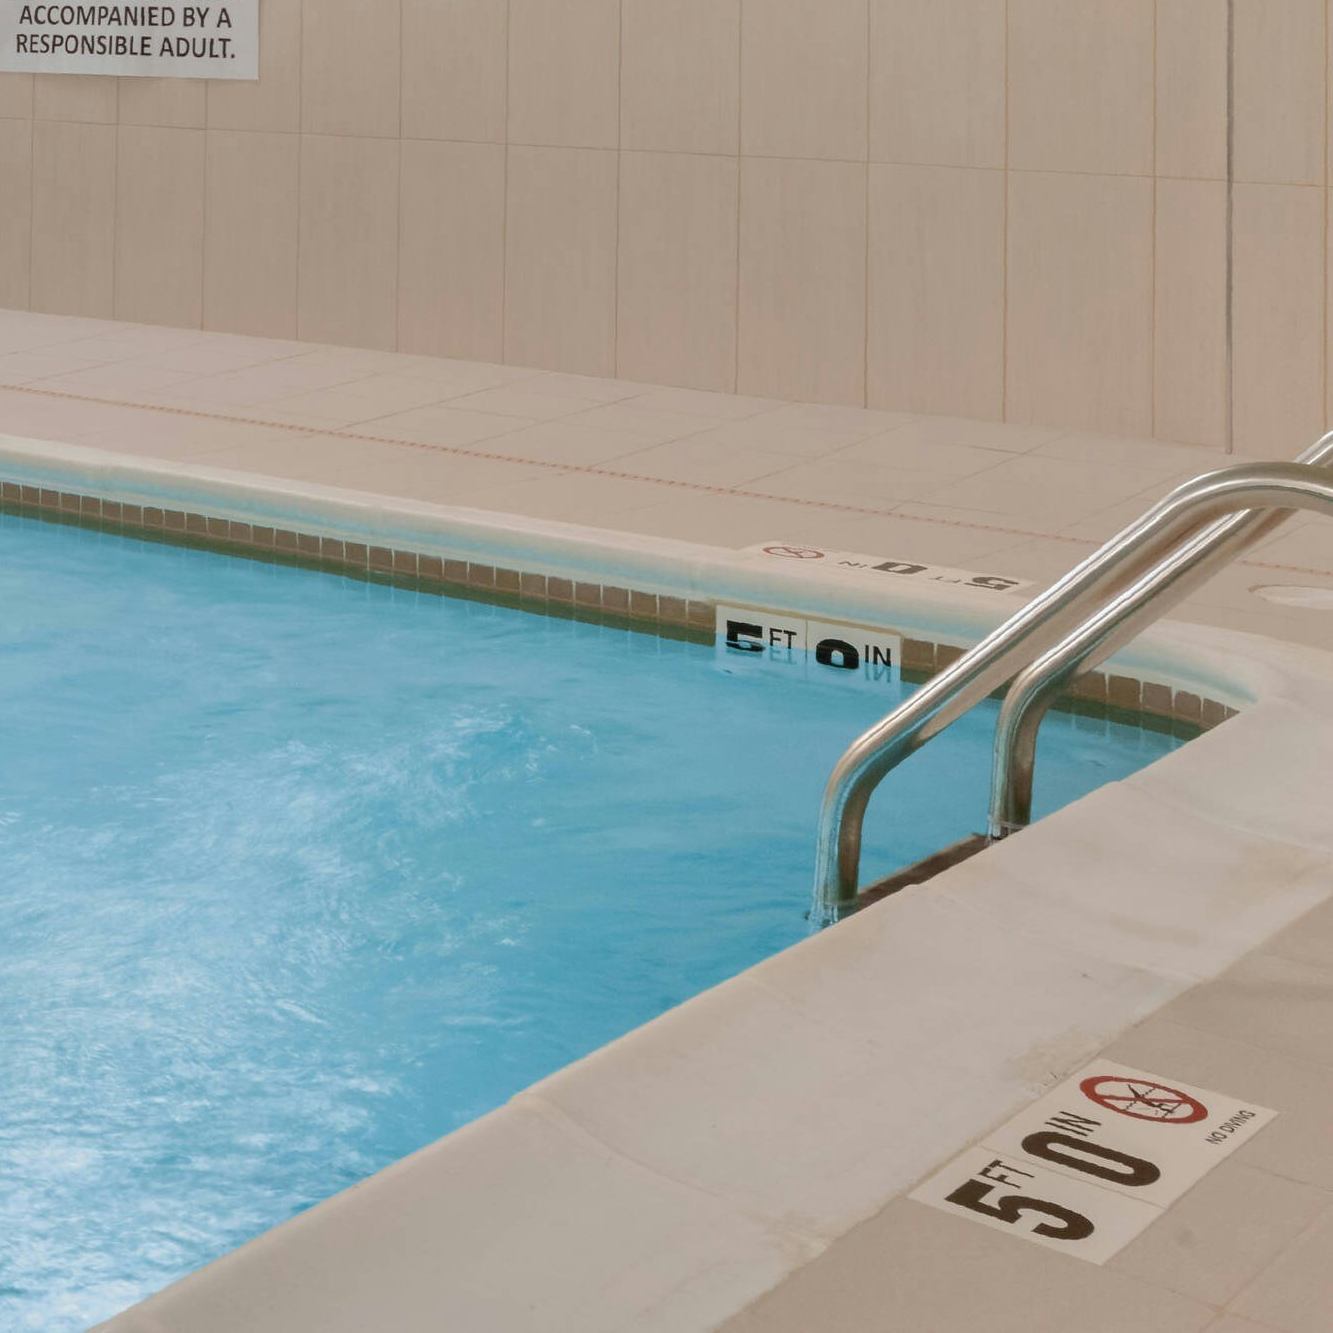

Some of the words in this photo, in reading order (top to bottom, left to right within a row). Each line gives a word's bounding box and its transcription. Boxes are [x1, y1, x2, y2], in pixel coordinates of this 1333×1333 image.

[19, 5, 175, 27] ACCOMPANIED
[183, 7, 209, 28] BY
[217, 8, 232, 28] A
[16, 34, 152, 56] RESPONSIBLE
[159, 37, 235, 59] ADULT.
[769, 627, 797, 650] FT
[865, 644, 892, 667] IN
[1045, 1110, 1102, 1137] IN
[1205, 1131, 1227, 1144] NO
[1219, 1110, 1255, 1133] DIVING
[979, 1158, 1035, 1189] FT
[1021, 1131, 1161, 1187] 0
[944, 1178, 1095, 1240] 5
